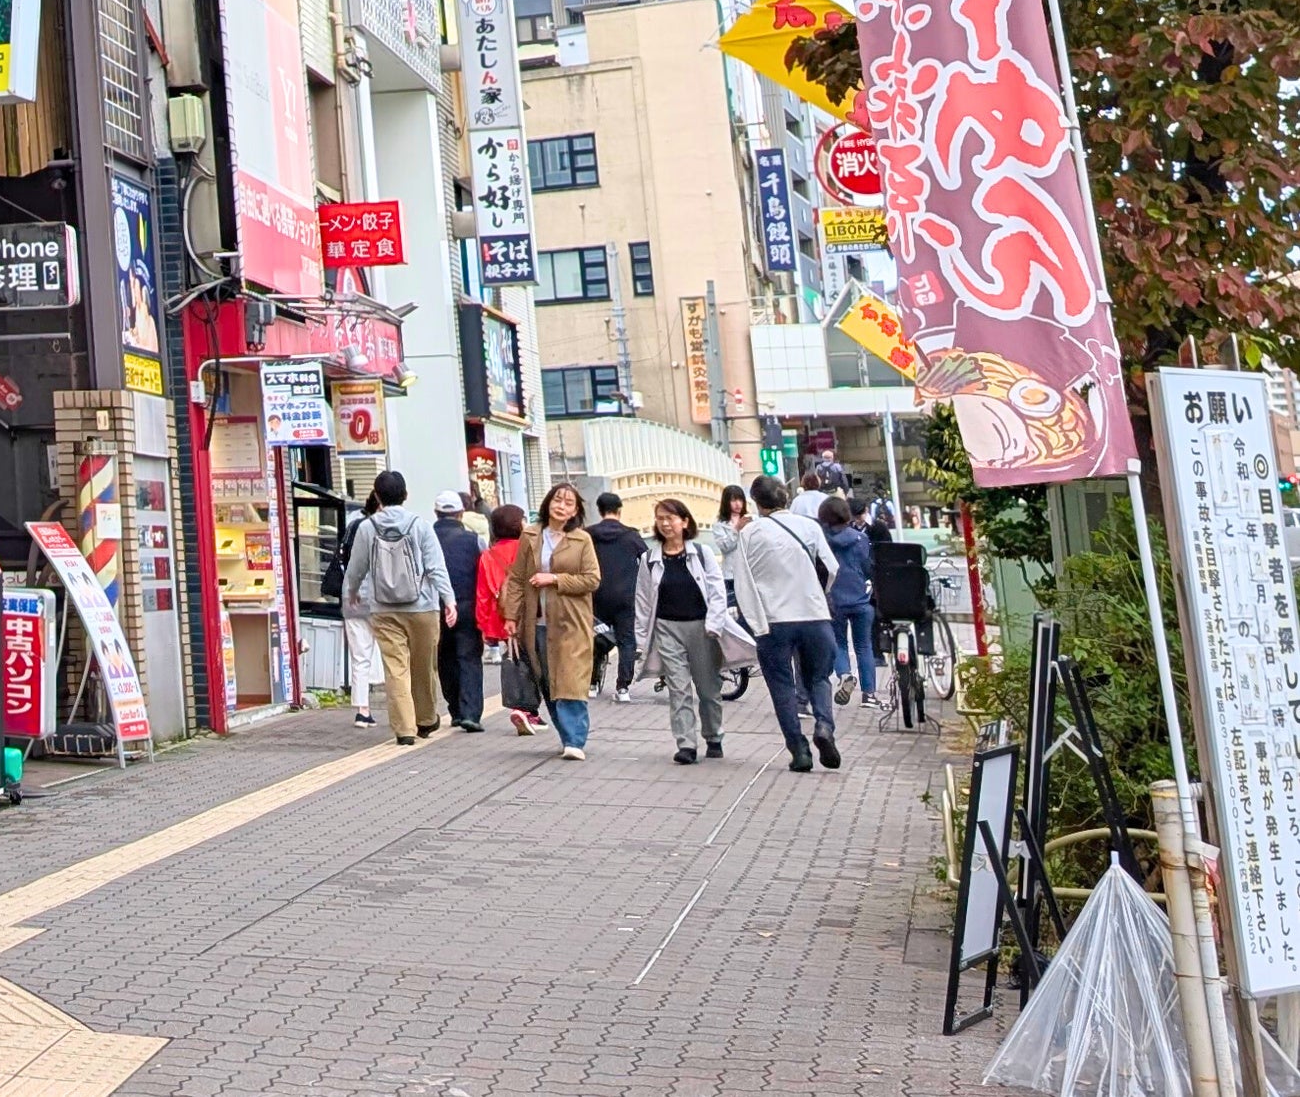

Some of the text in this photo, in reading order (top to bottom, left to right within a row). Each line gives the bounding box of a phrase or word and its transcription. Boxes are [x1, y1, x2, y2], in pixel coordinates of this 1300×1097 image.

[475, 4, 492, 13] バル
[474, 17, 503, 105] あたしん家
[840, 139, 855, 149] FIRE
[836, 150, 878, 179] 消火
[477, 137, 511, 229] から好し
[319, 211, 394, 233] ーメン・餃子
[761, 172, 792, 265] 千鳥饅頭
[326, 237, 396, 259] 華定食
[490, 238, 530, 263] そば
[485, 261, 532, 279] 親子丼
[282, 411, 322, 421] 料金診断
[1184, 390, 1253, 425] お願い
[4, 618, 34, 714] 中古パソコン
